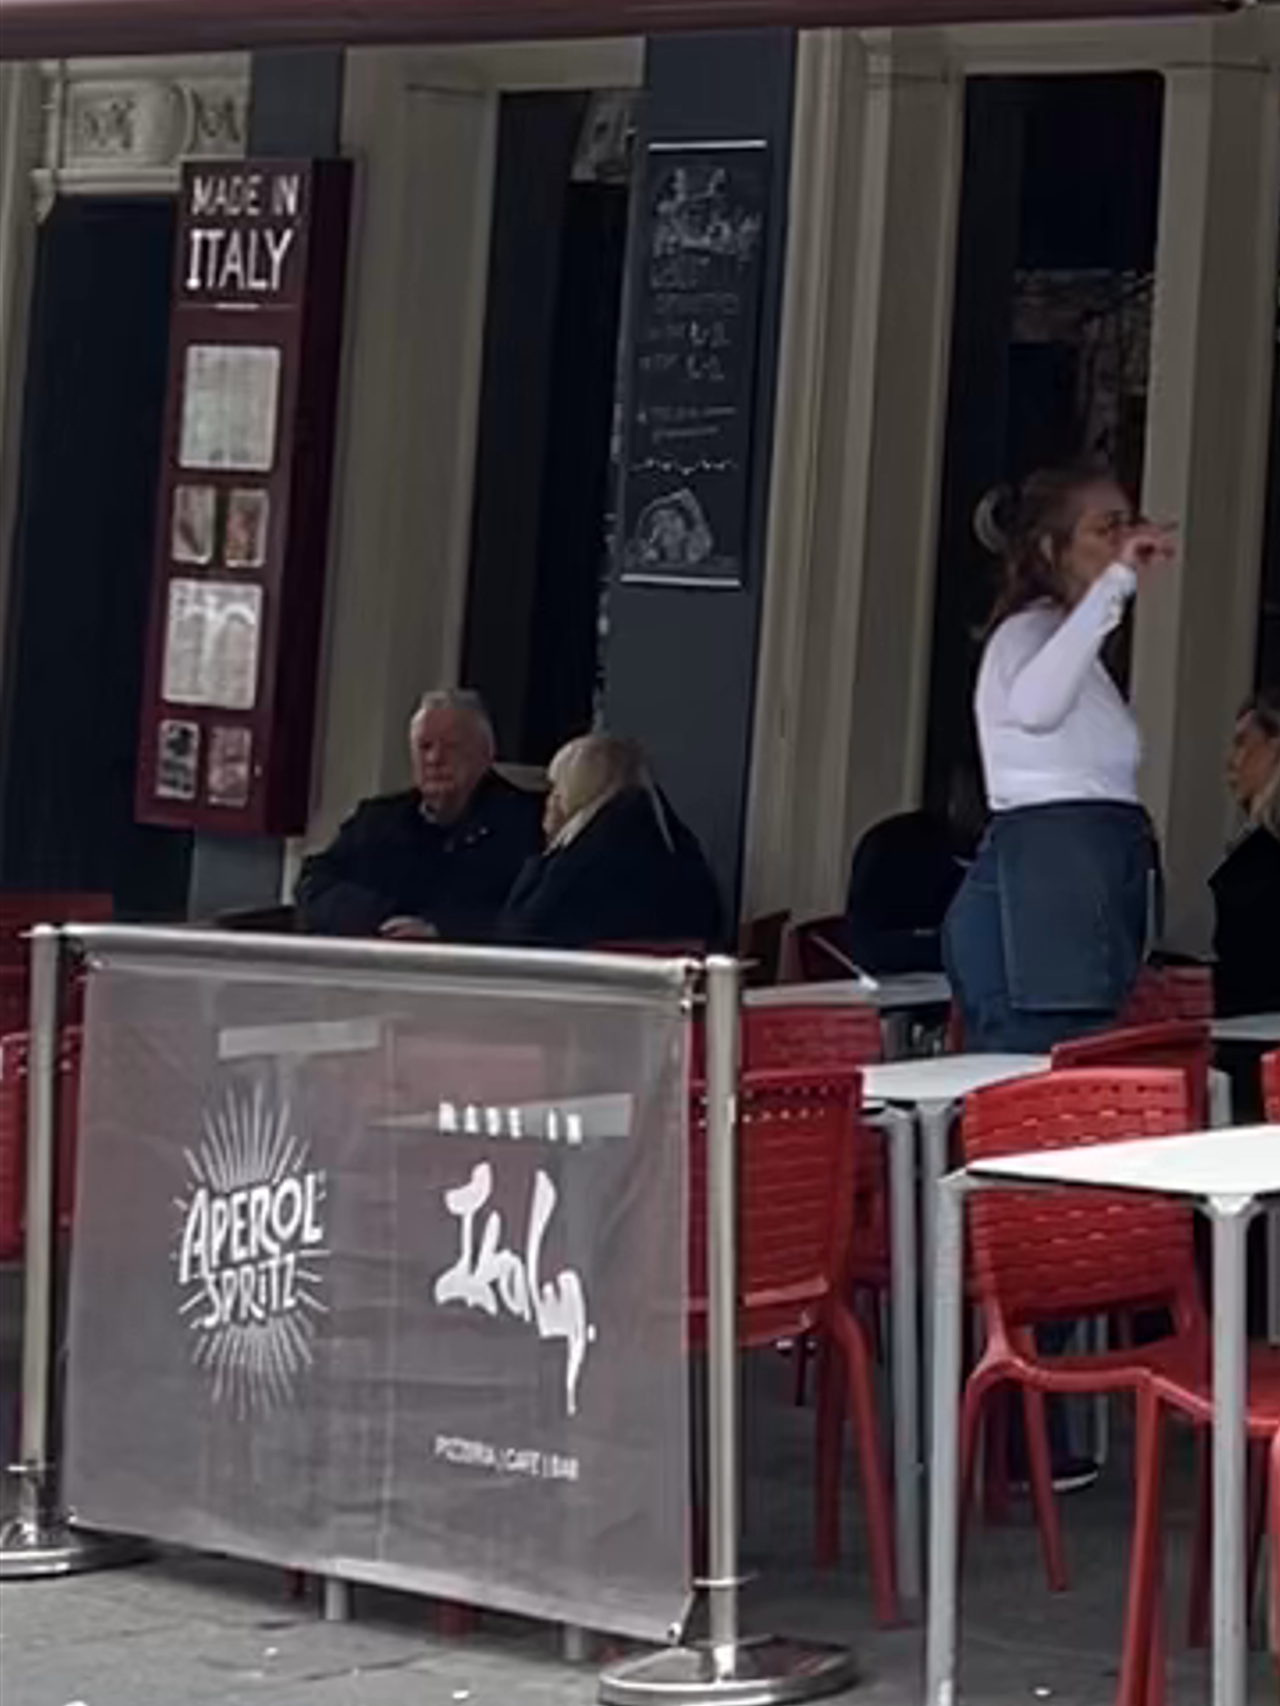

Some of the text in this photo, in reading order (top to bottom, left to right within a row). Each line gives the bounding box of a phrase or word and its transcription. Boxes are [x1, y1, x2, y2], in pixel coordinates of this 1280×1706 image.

[191, 173, 299, 216] MADE IN
[186, 227, 293, 291] ITALY
[179, 1173, 324, 1285] APEROL
